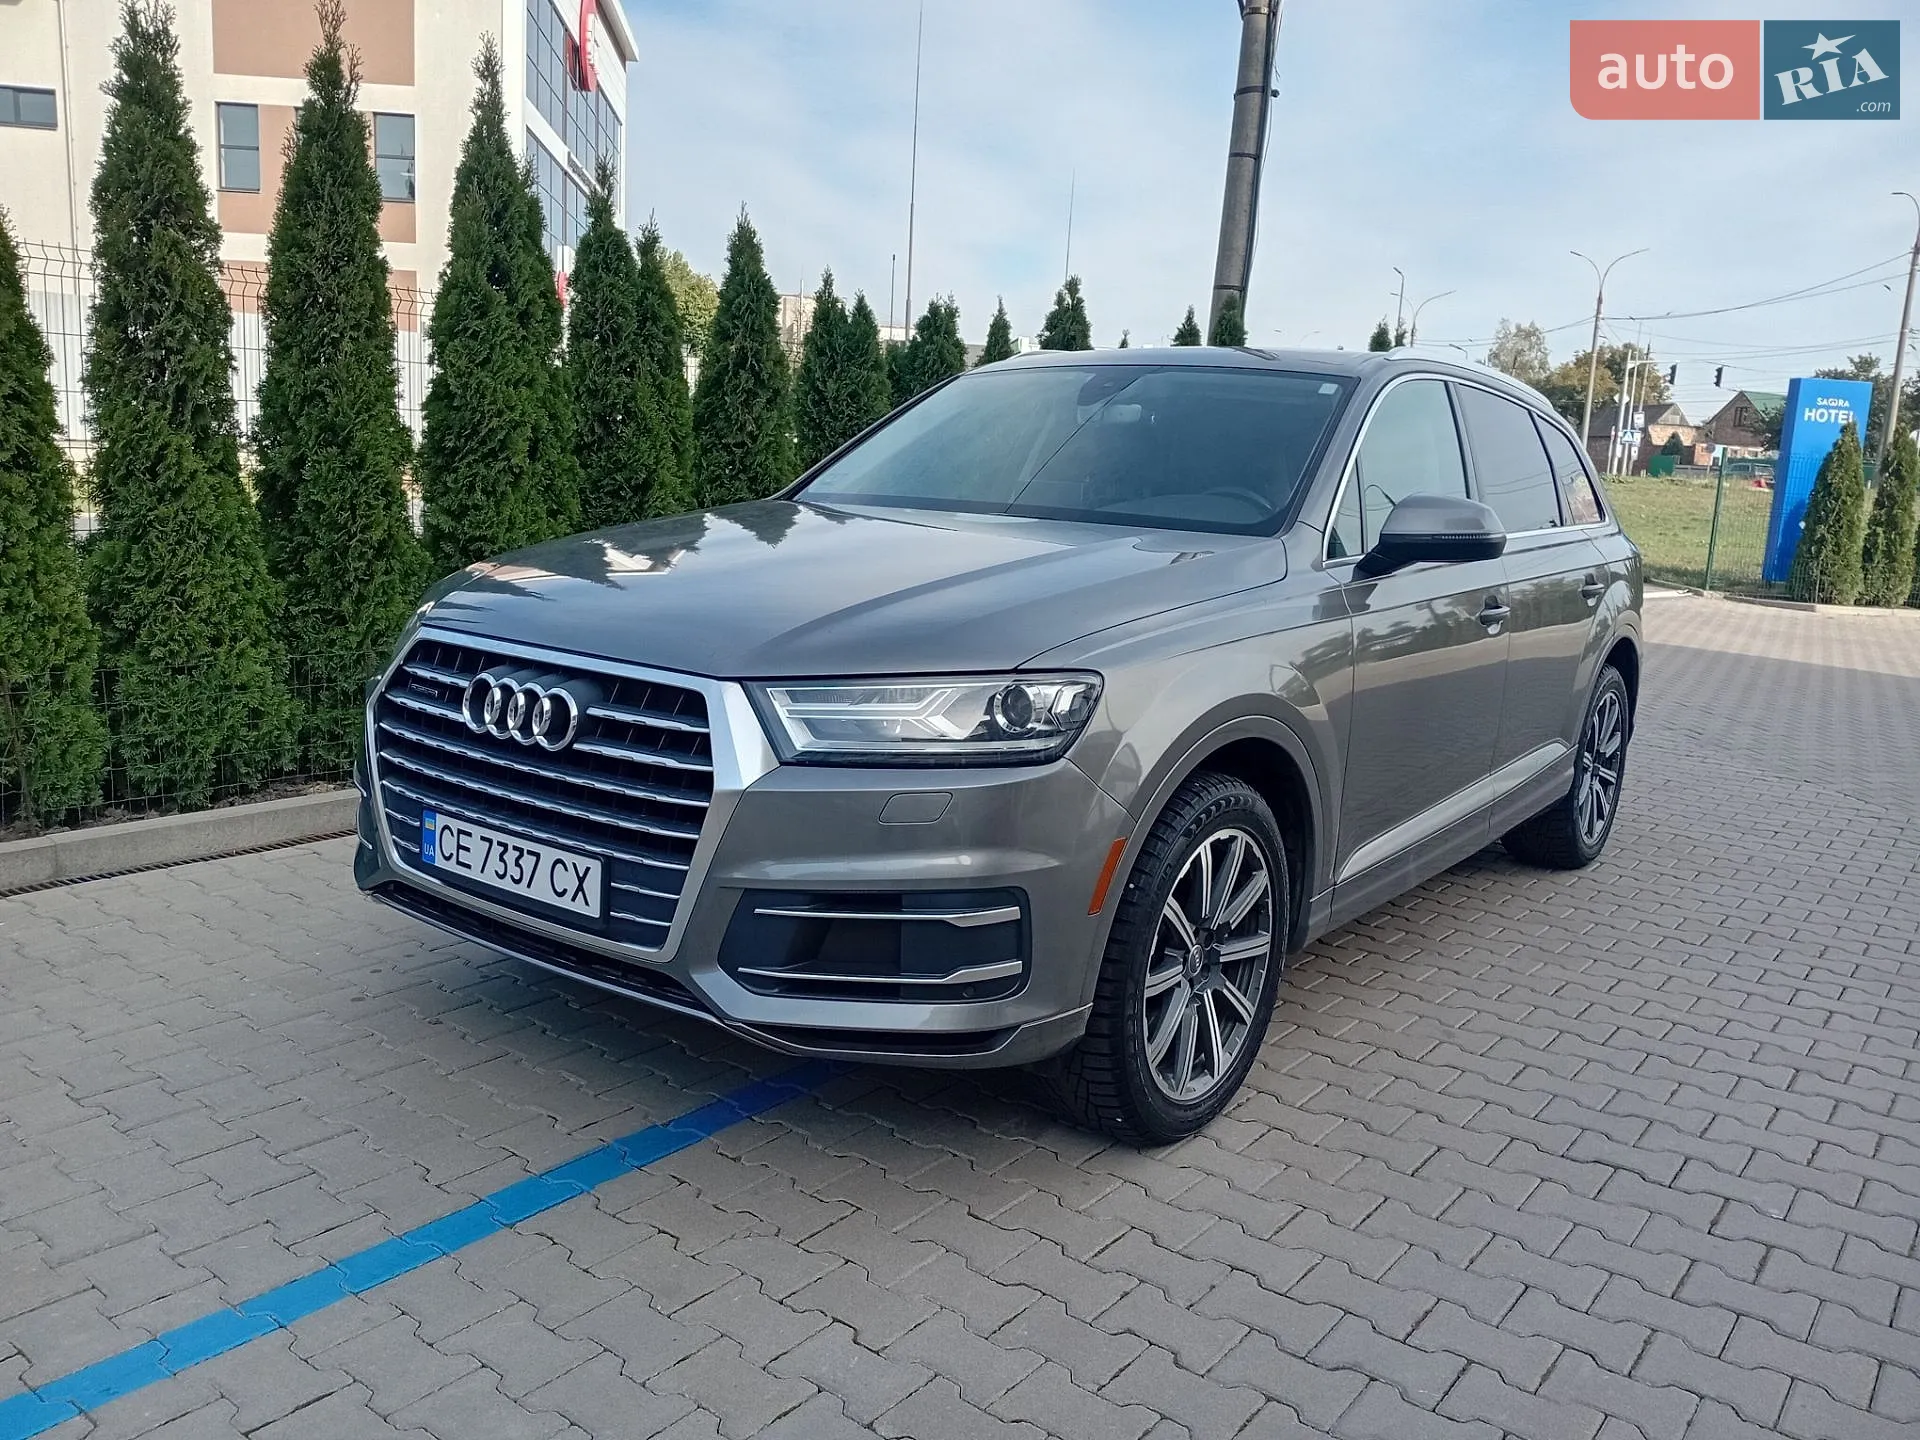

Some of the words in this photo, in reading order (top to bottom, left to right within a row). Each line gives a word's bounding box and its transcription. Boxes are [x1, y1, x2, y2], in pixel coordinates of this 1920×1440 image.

[424, 842, 435, 857] UA
[439, 824, 473, 870] CE
[479, 835, 541, 889] 7337
[550, 858, 592, 907] CX
